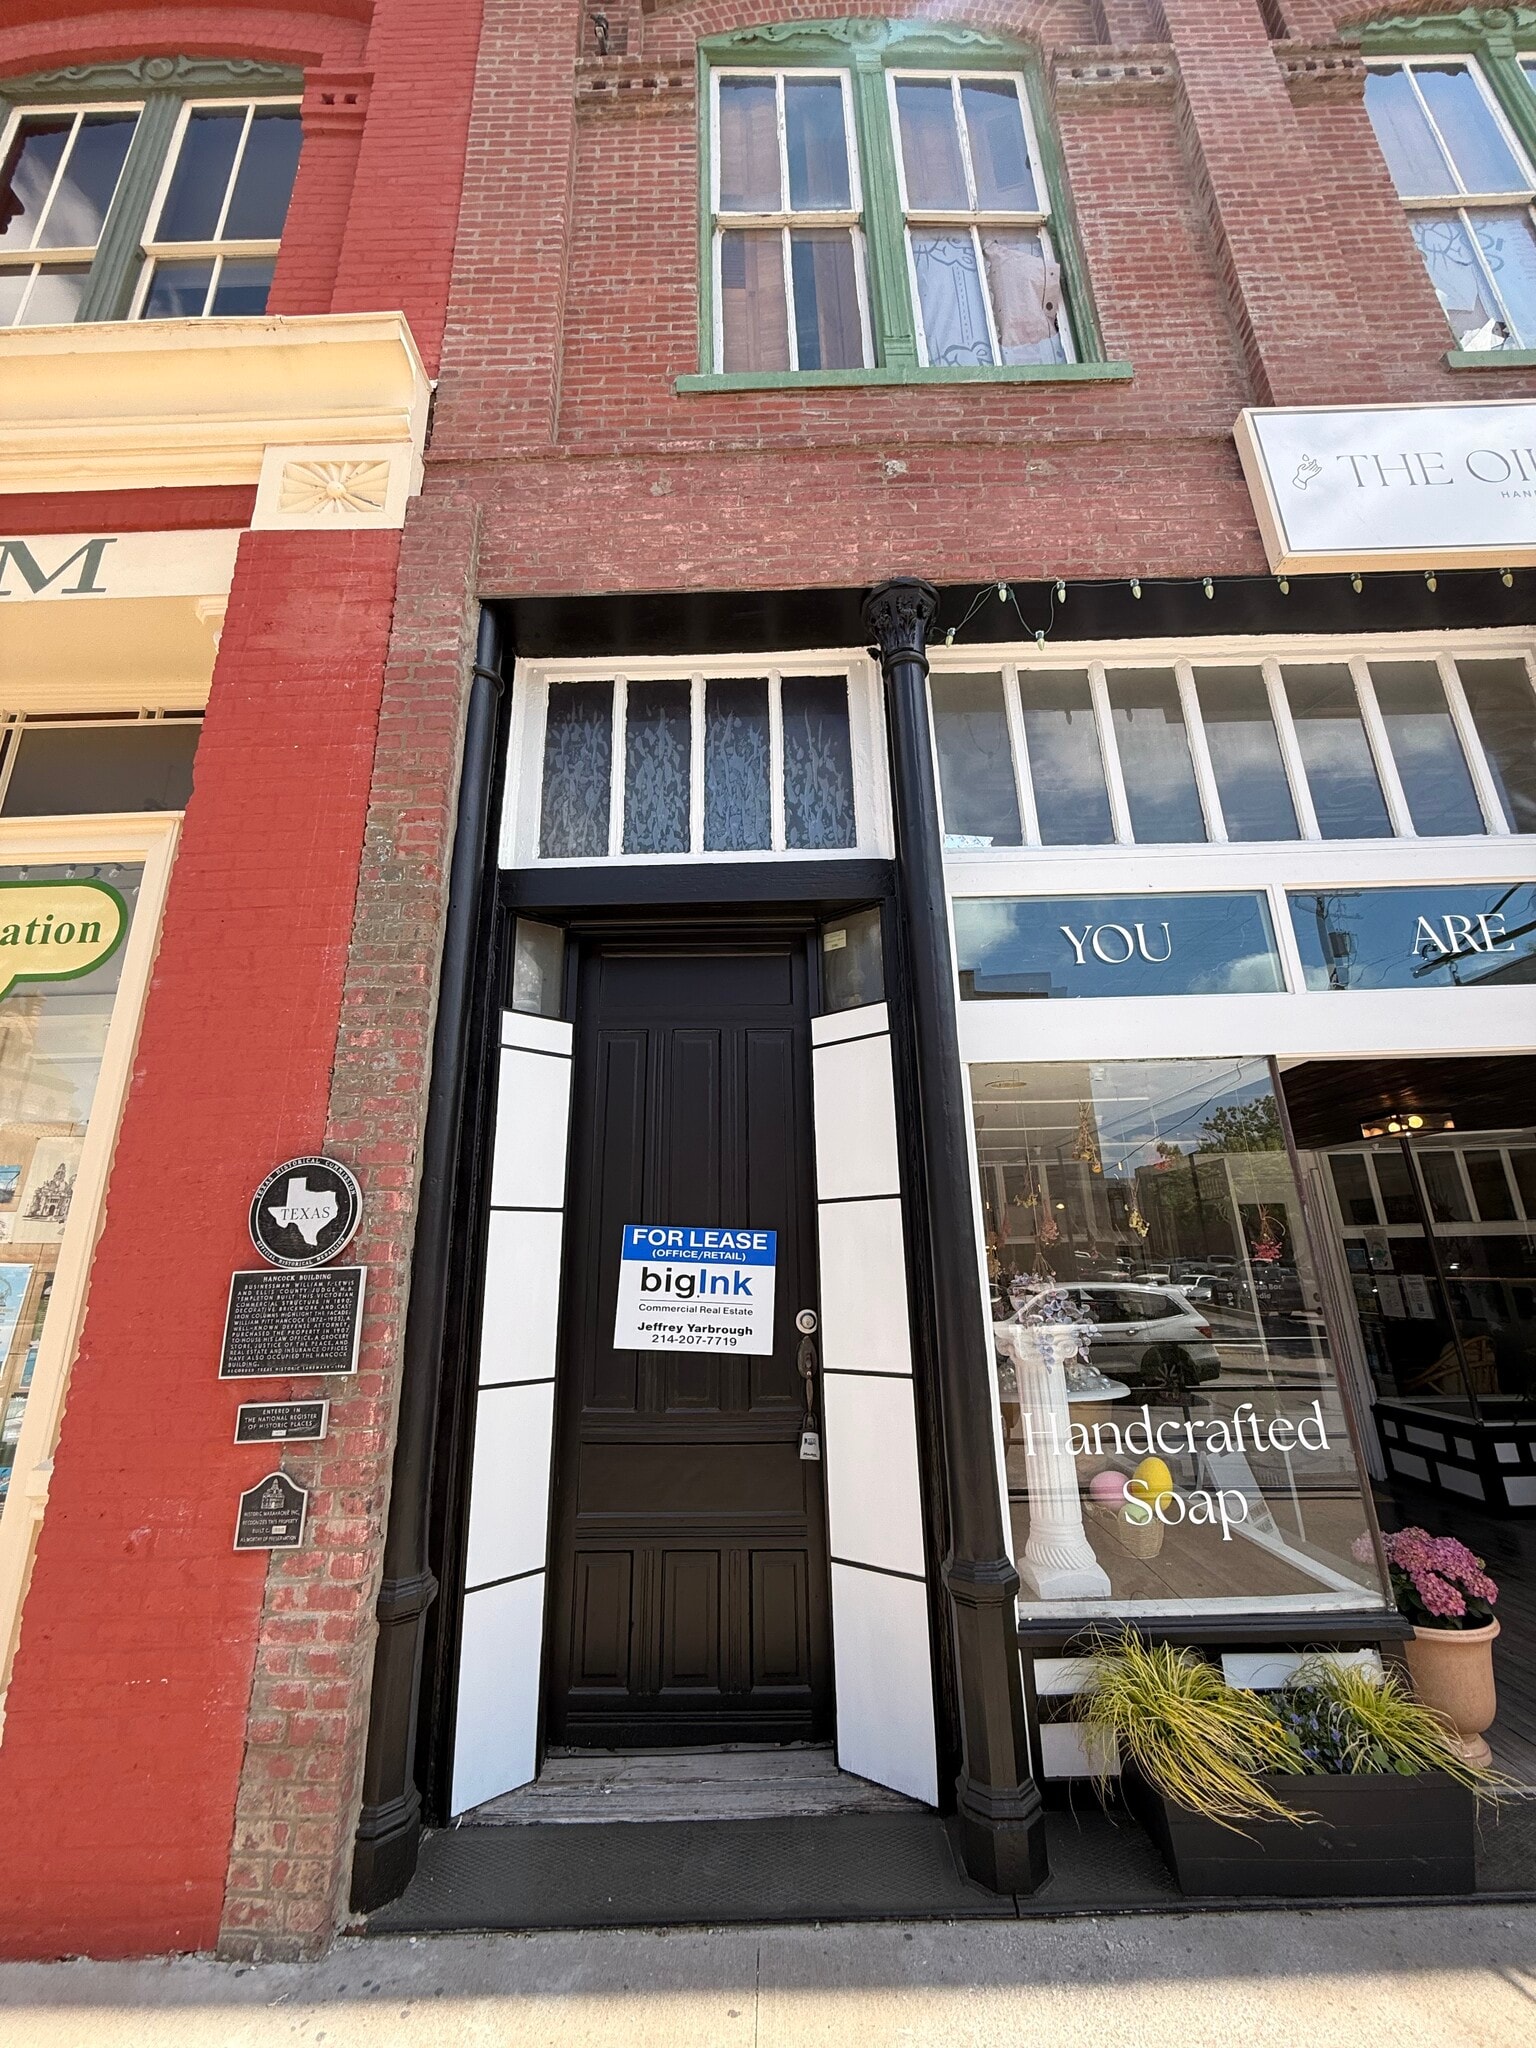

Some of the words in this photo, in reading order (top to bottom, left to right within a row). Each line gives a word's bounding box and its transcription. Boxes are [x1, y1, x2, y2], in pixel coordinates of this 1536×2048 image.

[1336, 452, 1453, 487] THE
[1501, 489, 1536, 499] HAN
[0, 914, 101, 946] ation
[1060, 922, 1171, 964] YOU
[1412, 913, 1515, 954] ARE
[256, 1176, 273, 1199] TEXAS
[276, 1158, 320, 1175] HISTORICAL
[325, 1161, 356, 1195] COMMISSION
[281, 1206, 330, 1220] TEXAS
[256, 1240, 276, 1261] OFFICIAL
[316, 1237, 344, 1262] MEDALLION
[632, 1228, 684, 1246] FOR
[690, 1231, 768, 1250] LEASE
[652, 1249, 746, 1262] (OFFICE/RETAIL)
[638, 1303, 698, 1314] Commercial
[700, 1306, 721, 1314] Real
[723, 1306, 754, 1316] Estate
[637, 1322, 683, 1333] Jeffrey
[687, 1324, 753, 1336] Yarbrough
[652, 1334, 737, 1346] 214-207-7719
[1023, 1400, 1330, 1456] Handcrafted
[1123, 1479, 1248, 1541] Soap
